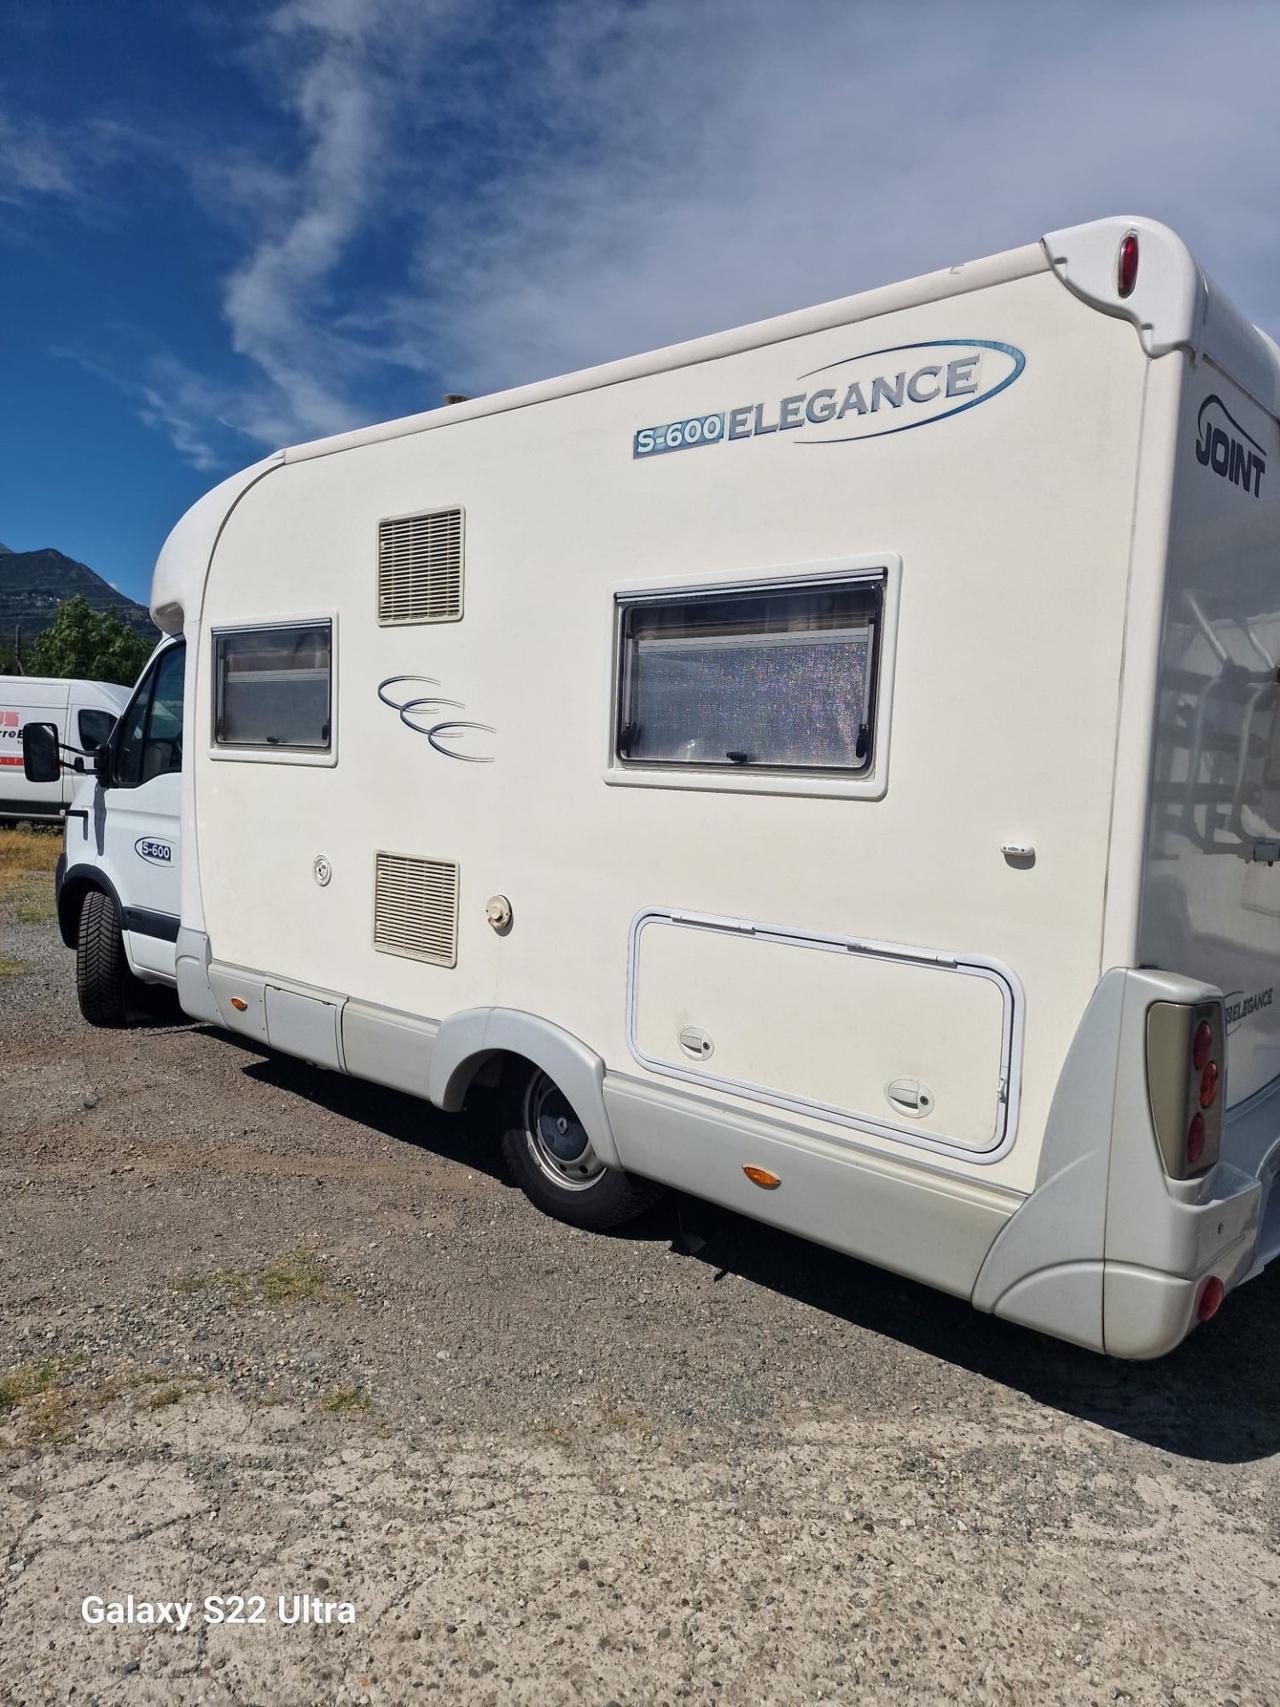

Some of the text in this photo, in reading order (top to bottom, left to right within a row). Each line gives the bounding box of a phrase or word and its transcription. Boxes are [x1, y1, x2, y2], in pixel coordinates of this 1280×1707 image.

[637, 354, 980, 453] S-600 ELEGANCE
[1196, 421, 1265, 498] JOINT
[142, 842, 170, 859] S-600
[1232, 987, 1273, 1022] ELEGANCE
